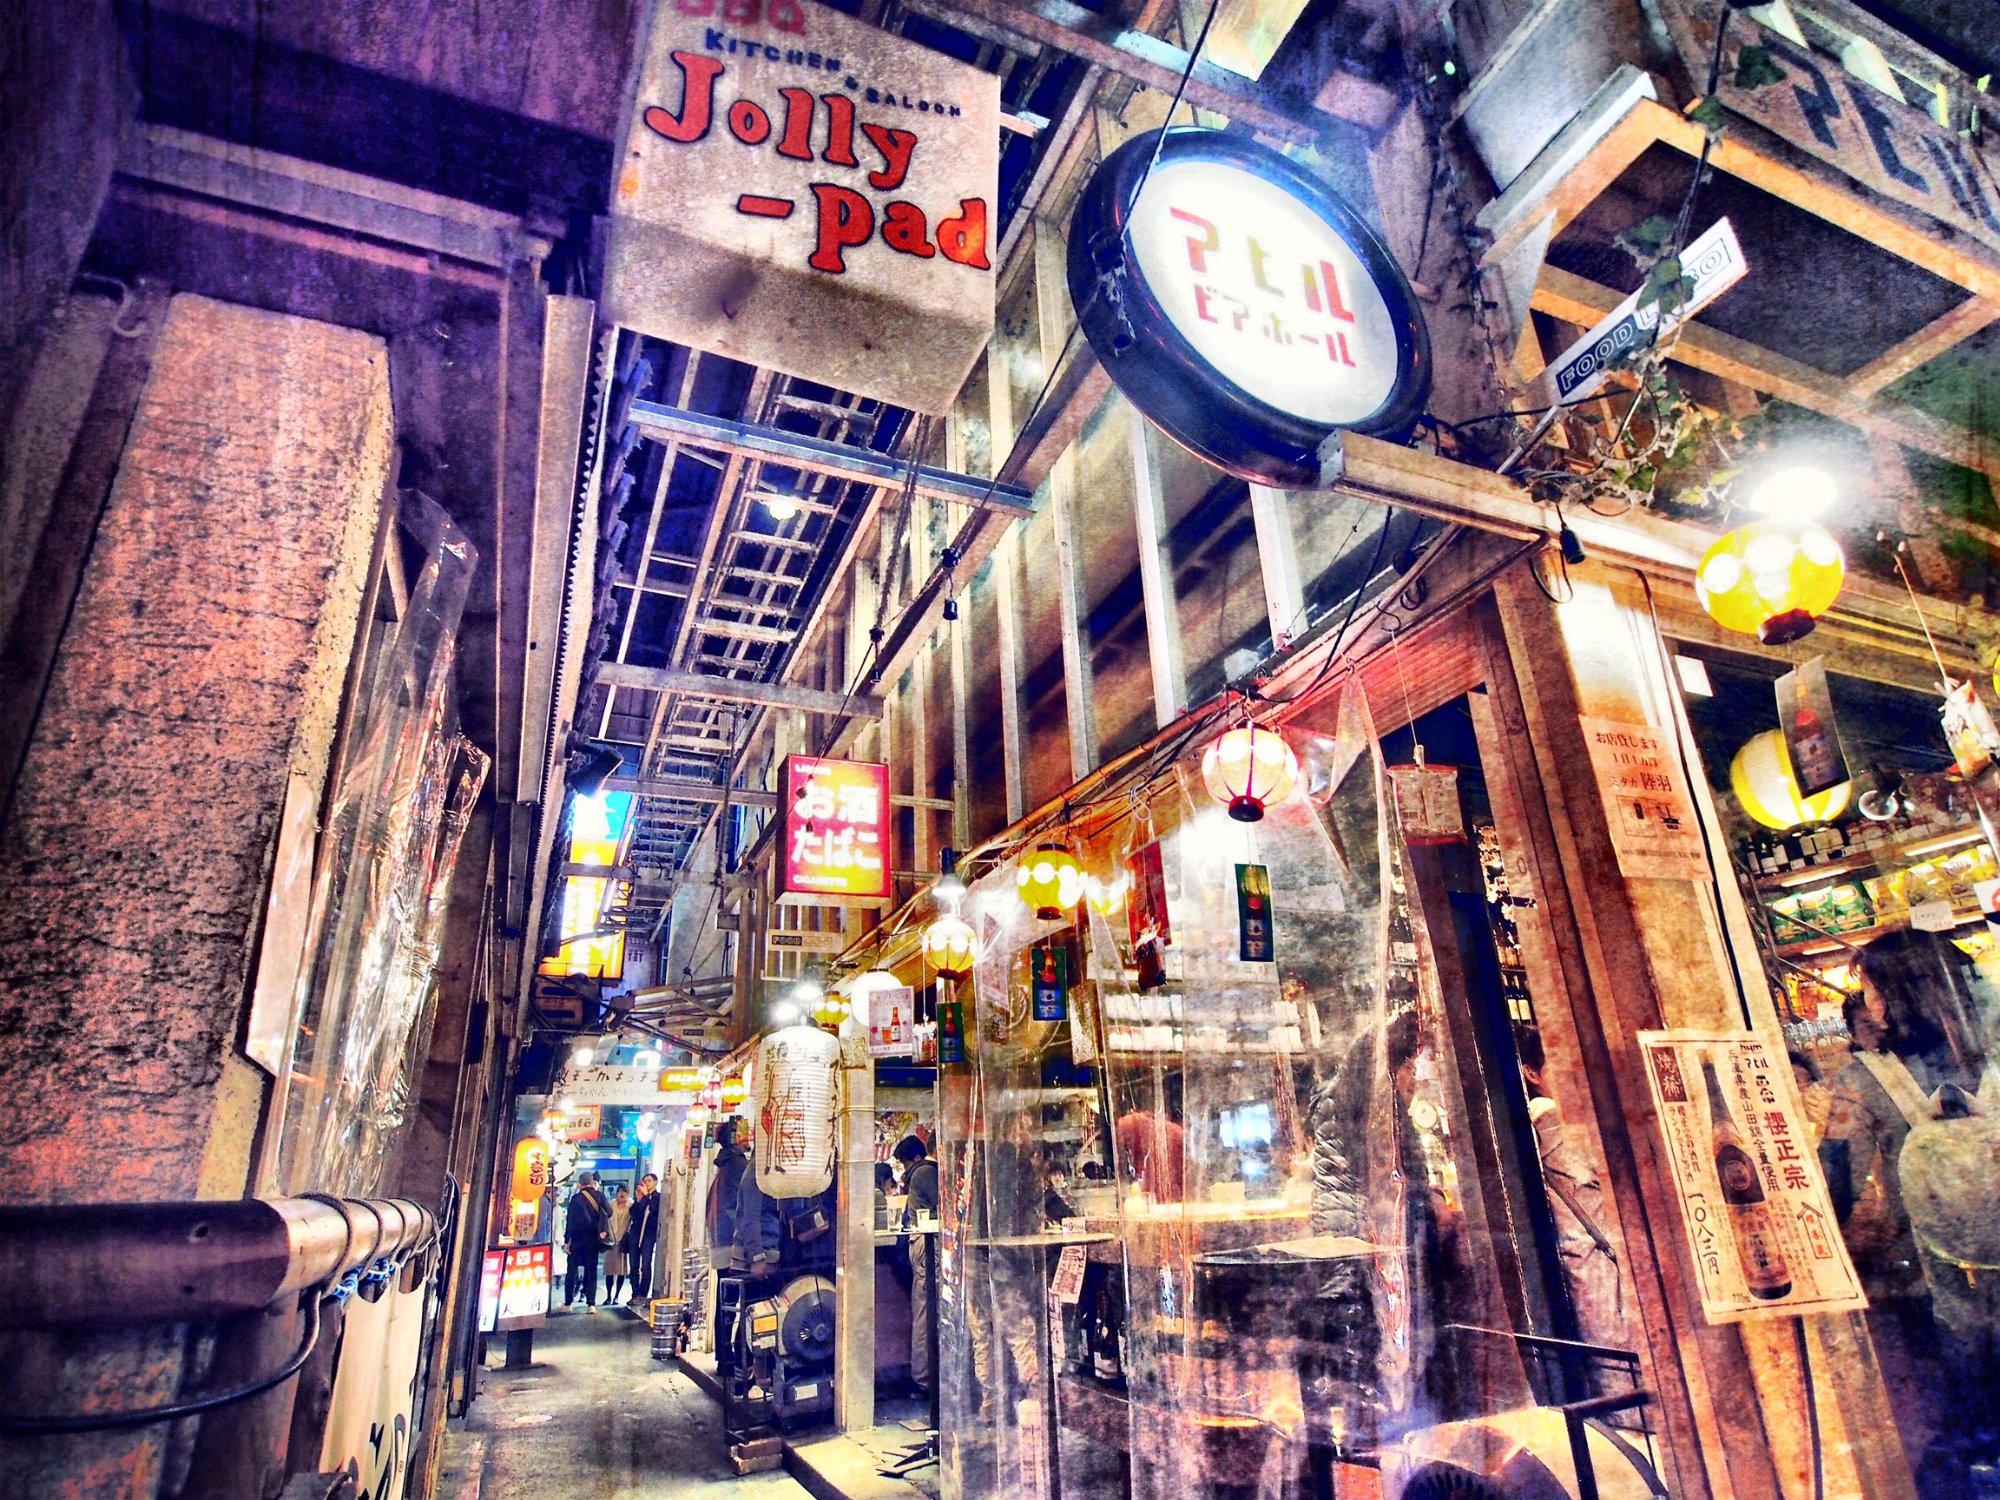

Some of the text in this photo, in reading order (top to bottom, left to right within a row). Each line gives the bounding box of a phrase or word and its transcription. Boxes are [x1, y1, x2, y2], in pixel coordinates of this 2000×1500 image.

[704, 27, 842, 72] KITCHEN
[865, 86, 962, 118] SALOON
[643, 50, 918, 191] Jolly
[1169, 206, 1356, 324] アヒル
[1192, 284, 1357, 369] ビアホール
[1558, 321, 1634, 392] FOOD
[793, 781, 879, 825] お酒
[790, 824, 882, 870] たばこ
